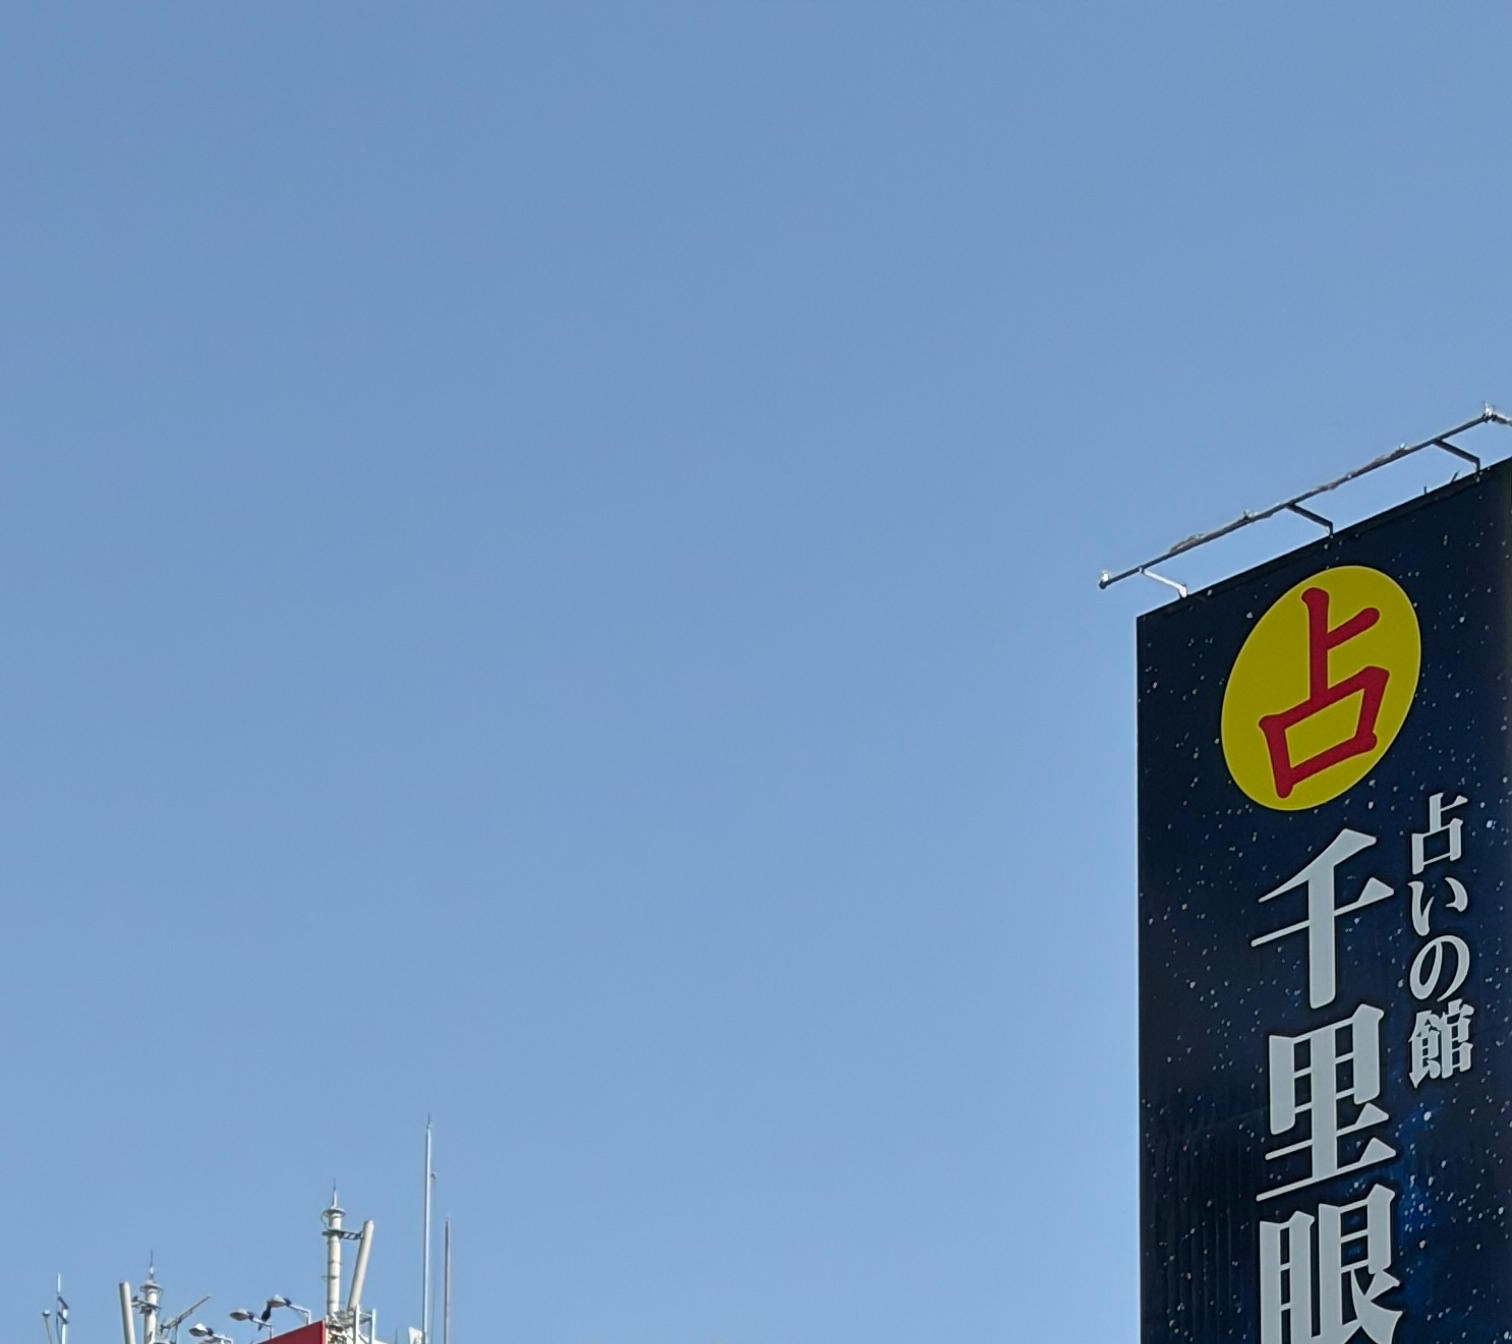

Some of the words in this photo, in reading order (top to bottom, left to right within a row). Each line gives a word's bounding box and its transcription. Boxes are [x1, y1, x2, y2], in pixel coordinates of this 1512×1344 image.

[1257, 586, 1390, 800] 占
[1407, 792, 1475, 1089] 占いの館
